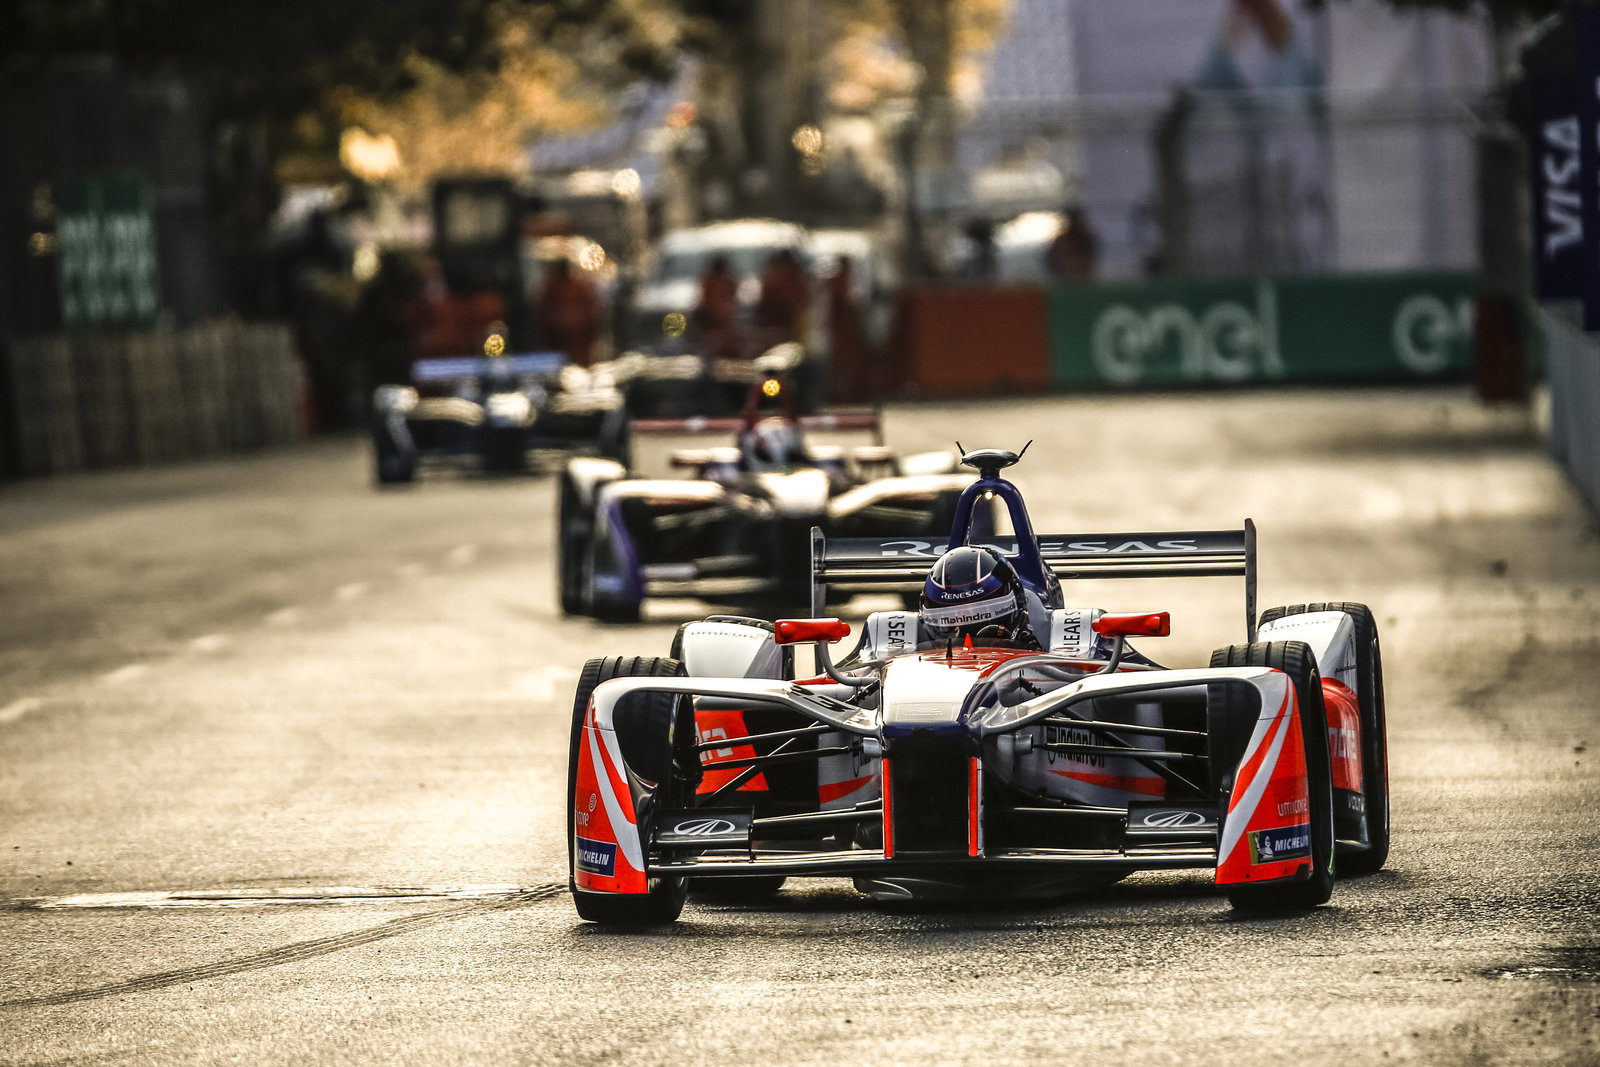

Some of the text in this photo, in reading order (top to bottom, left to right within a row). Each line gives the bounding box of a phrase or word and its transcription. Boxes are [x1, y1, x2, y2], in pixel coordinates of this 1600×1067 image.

[1542, 115, 1584, 258] VISA
[1092, 277, 1285, 384] enel
[941, 587, 984, 600] RENESAS
[940, 611, 992, 625] Mahindra
[1276, 796, 1307, 816] umicore
[1274, 834, 1309, 852] MICHELIN
